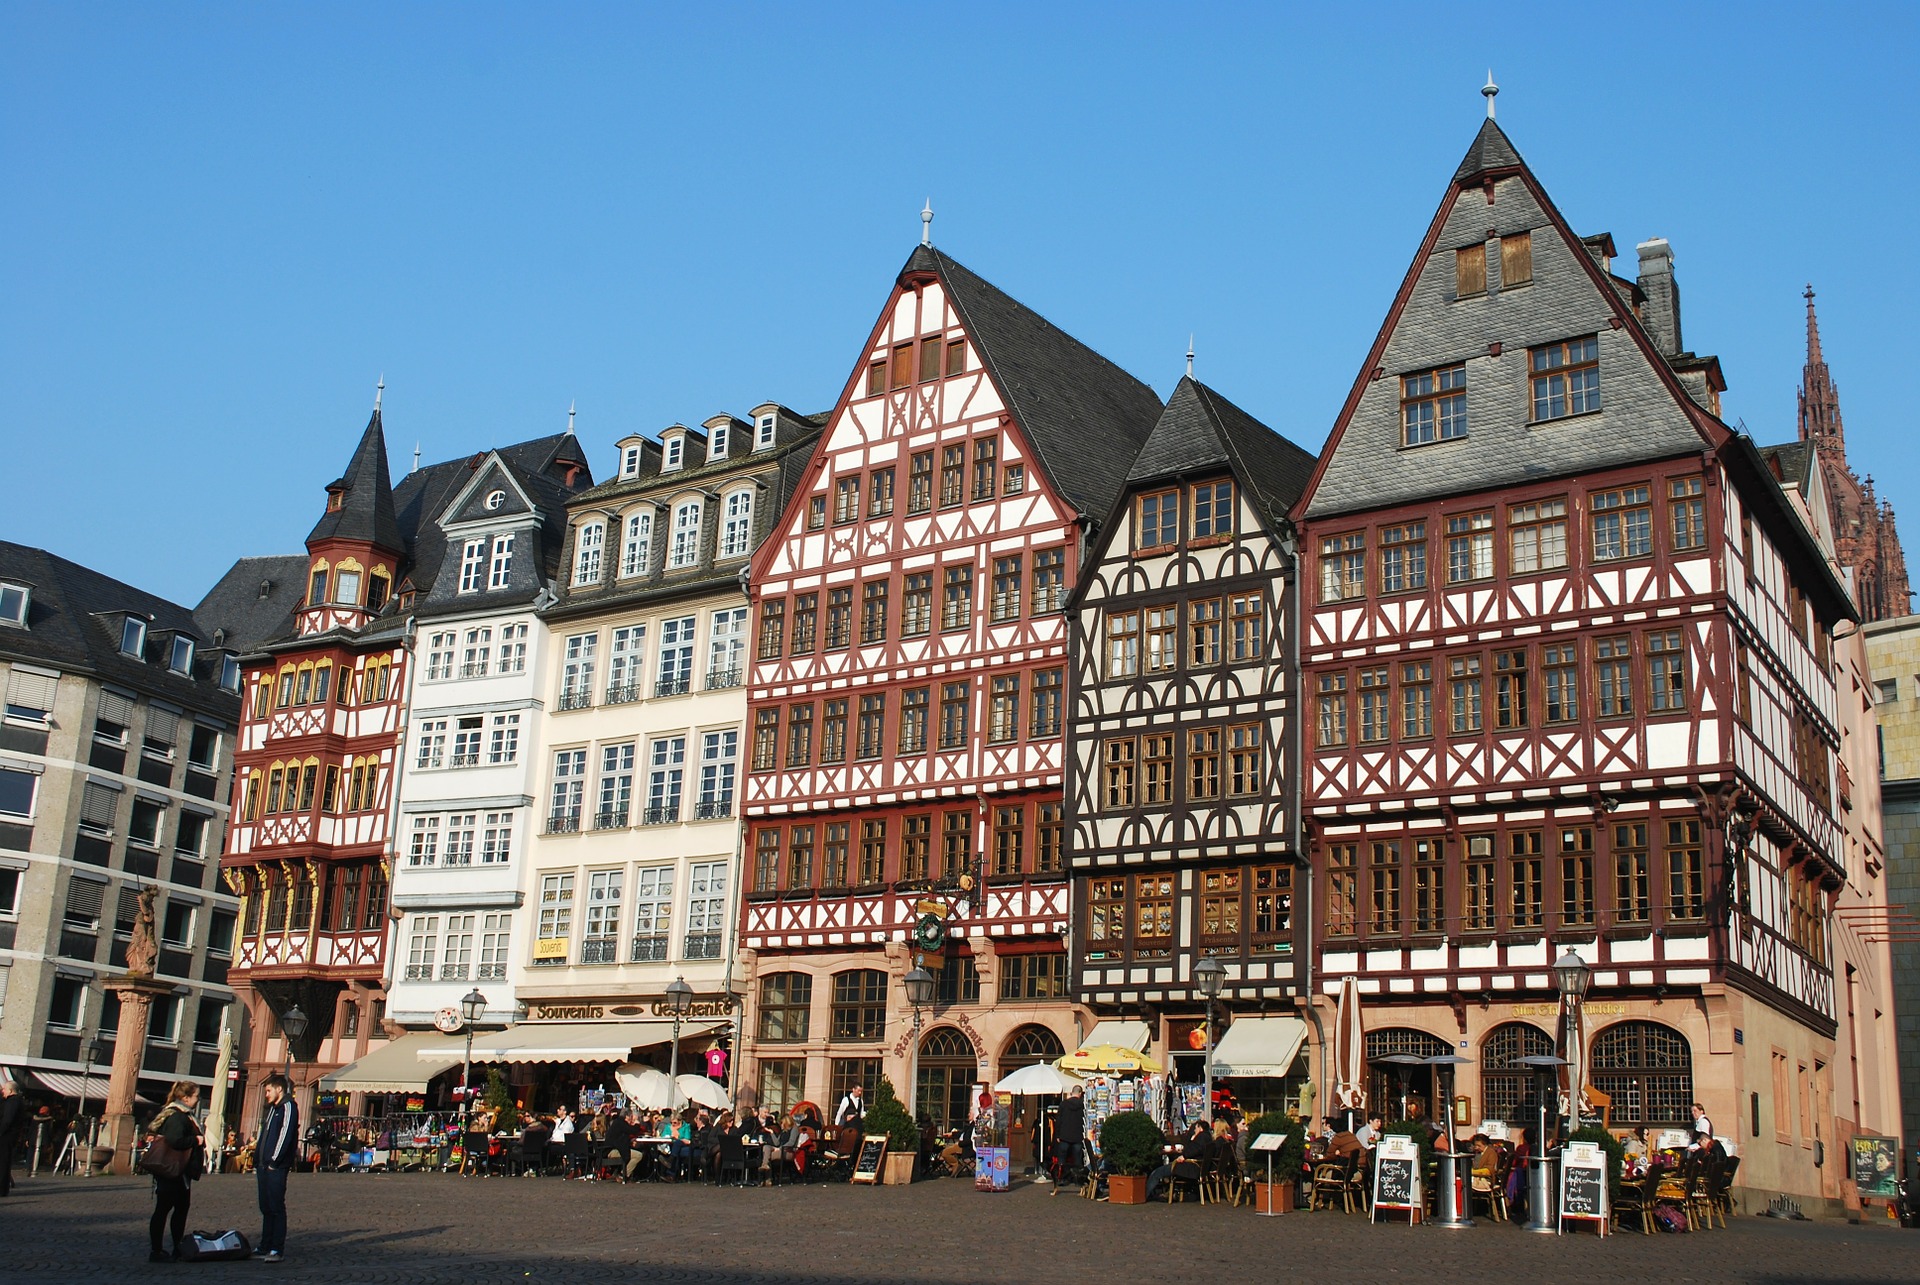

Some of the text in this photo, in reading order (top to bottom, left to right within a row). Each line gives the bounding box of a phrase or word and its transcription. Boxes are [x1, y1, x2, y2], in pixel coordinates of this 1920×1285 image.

[1137, 938, 1167, 947] Souvenir
[1204, 936, 1234, 944] Präsente
[1251, 932, 1291, 943] Volkskunst
[1092, 941, 1117, 949] Bembel
[537, 1002, 604, 1019] Souvenirs
[1512, 1004, 1536, 1018] Zum
[957, 1013, 989, 1059] Bembel
